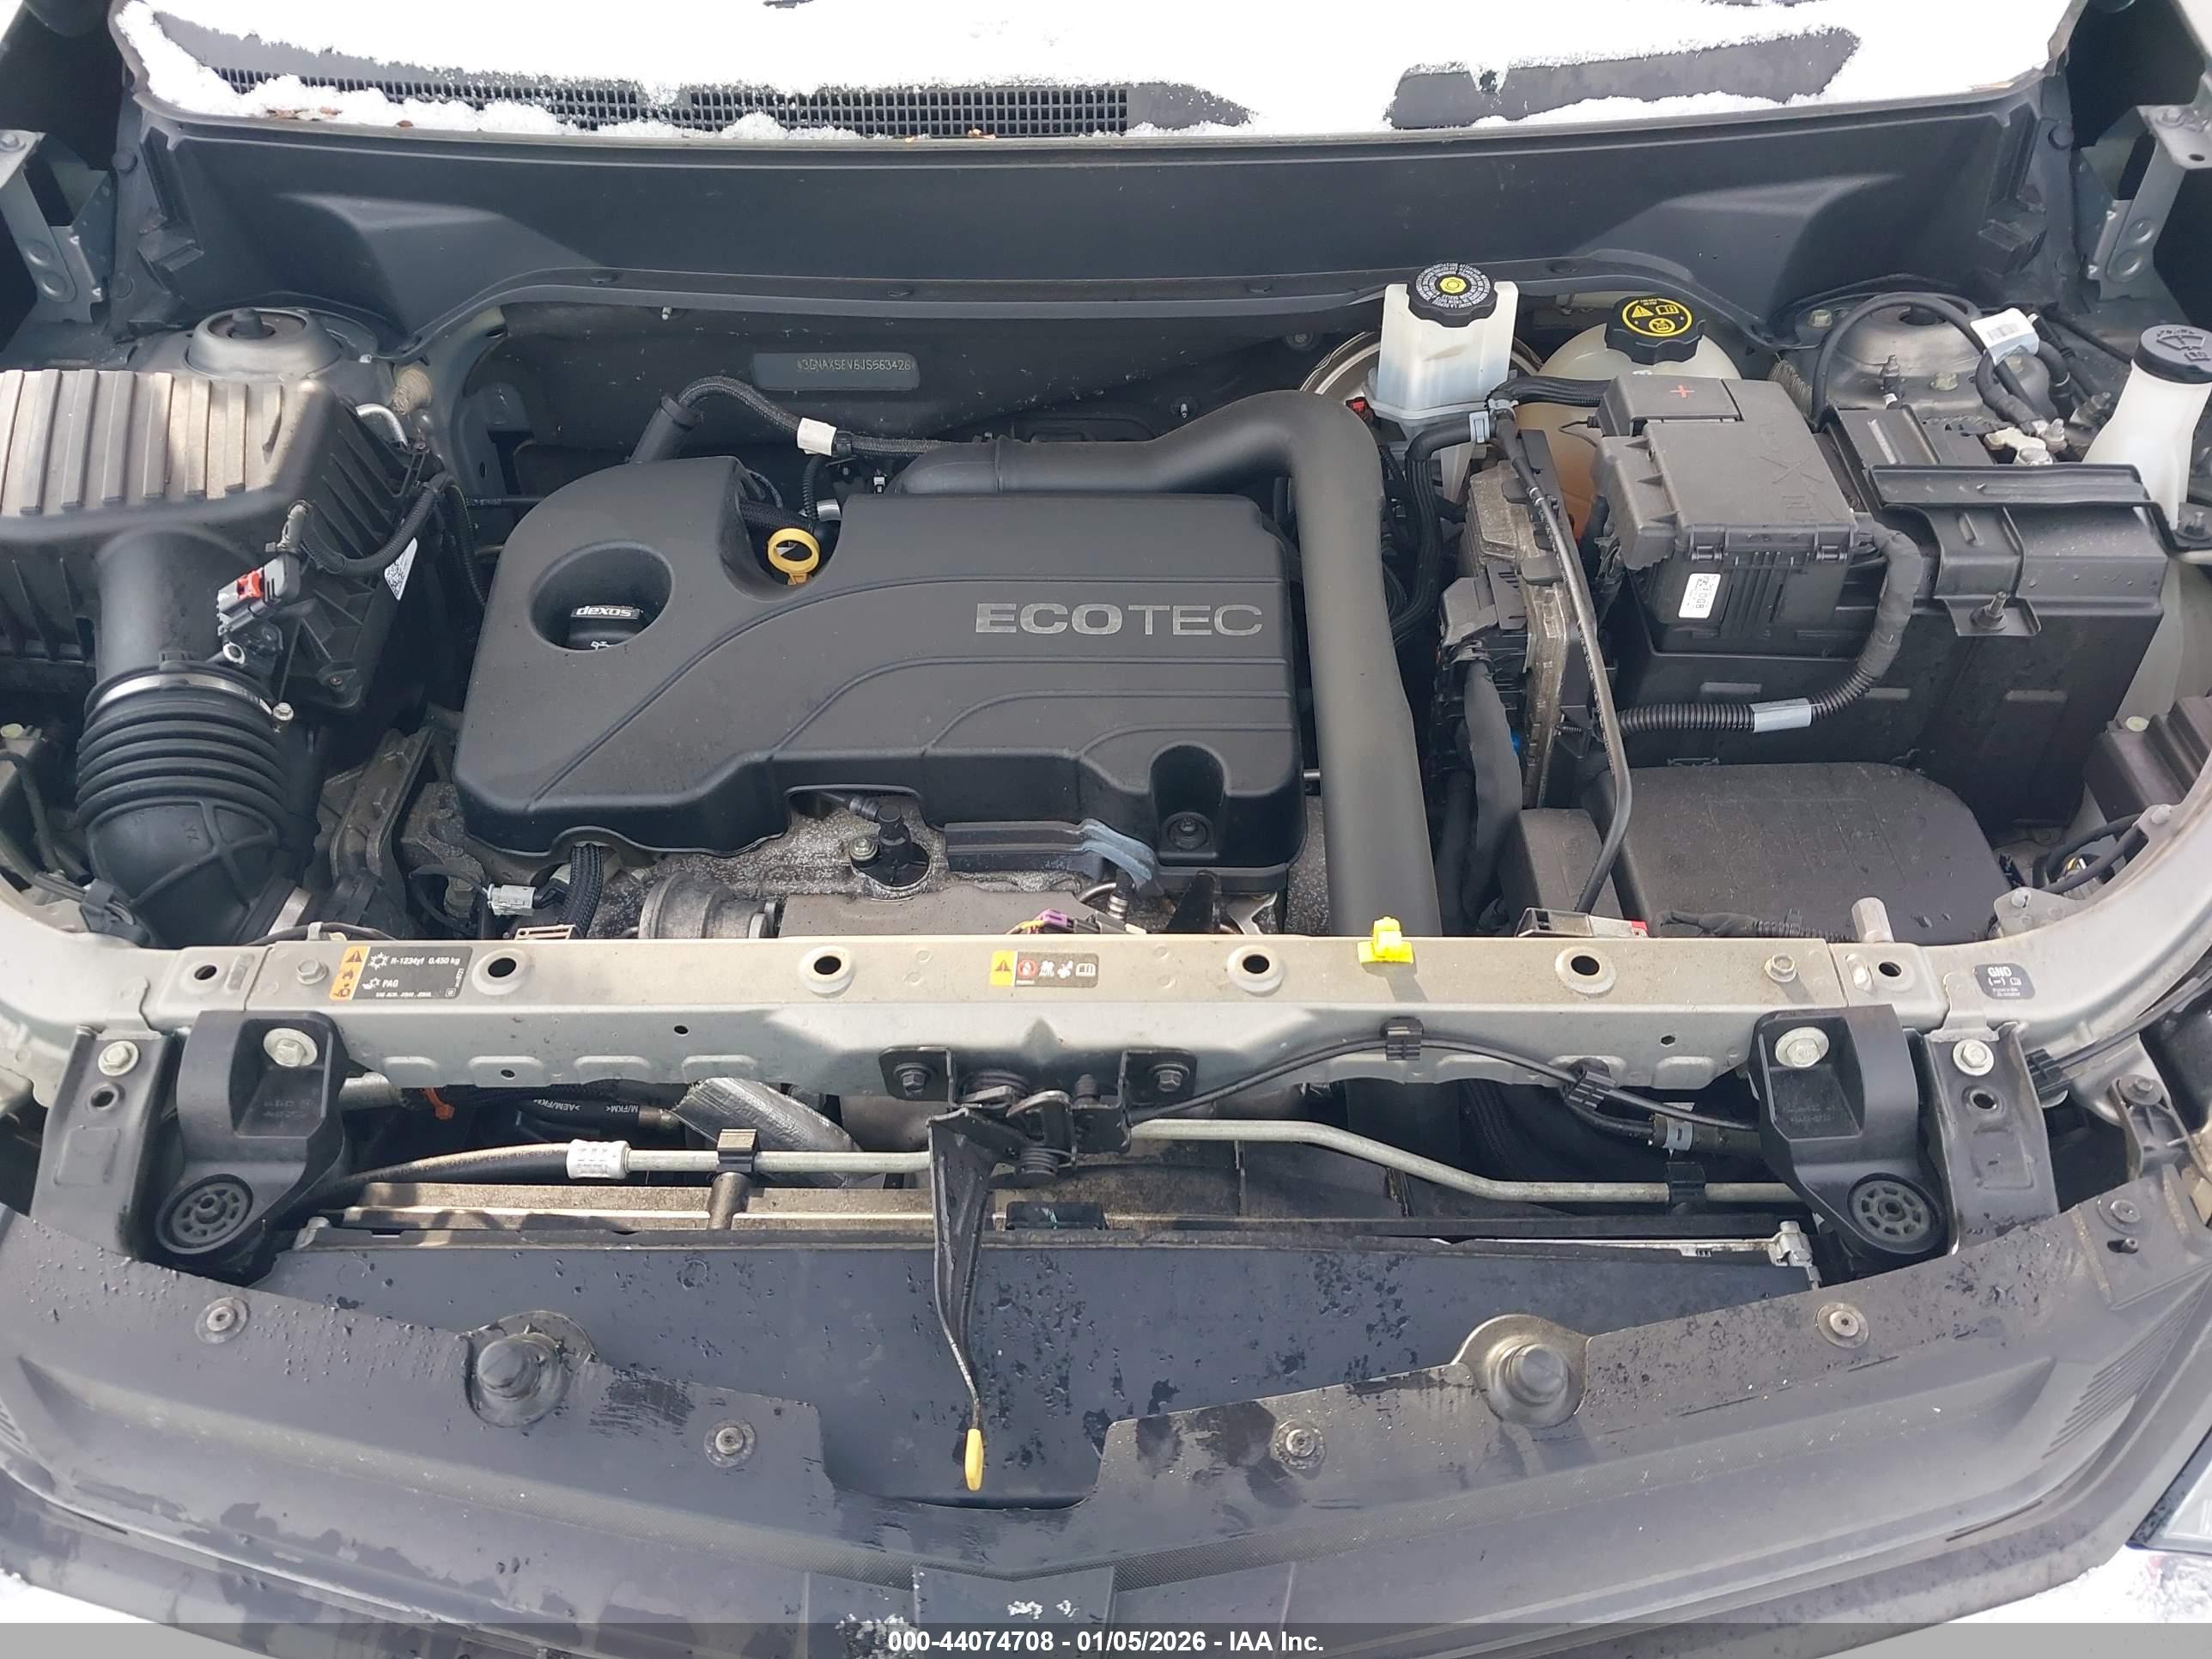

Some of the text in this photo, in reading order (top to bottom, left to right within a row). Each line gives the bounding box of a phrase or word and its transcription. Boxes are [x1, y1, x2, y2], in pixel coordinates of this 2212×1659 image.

[576, 605, 632, 617] dexos
[975, 603, 1263, 636] ECOTEC
[450, 957, 461, 966] kg
[1988, 966, 2012, 977] GND
[382, 979, 399, 988] PAG
